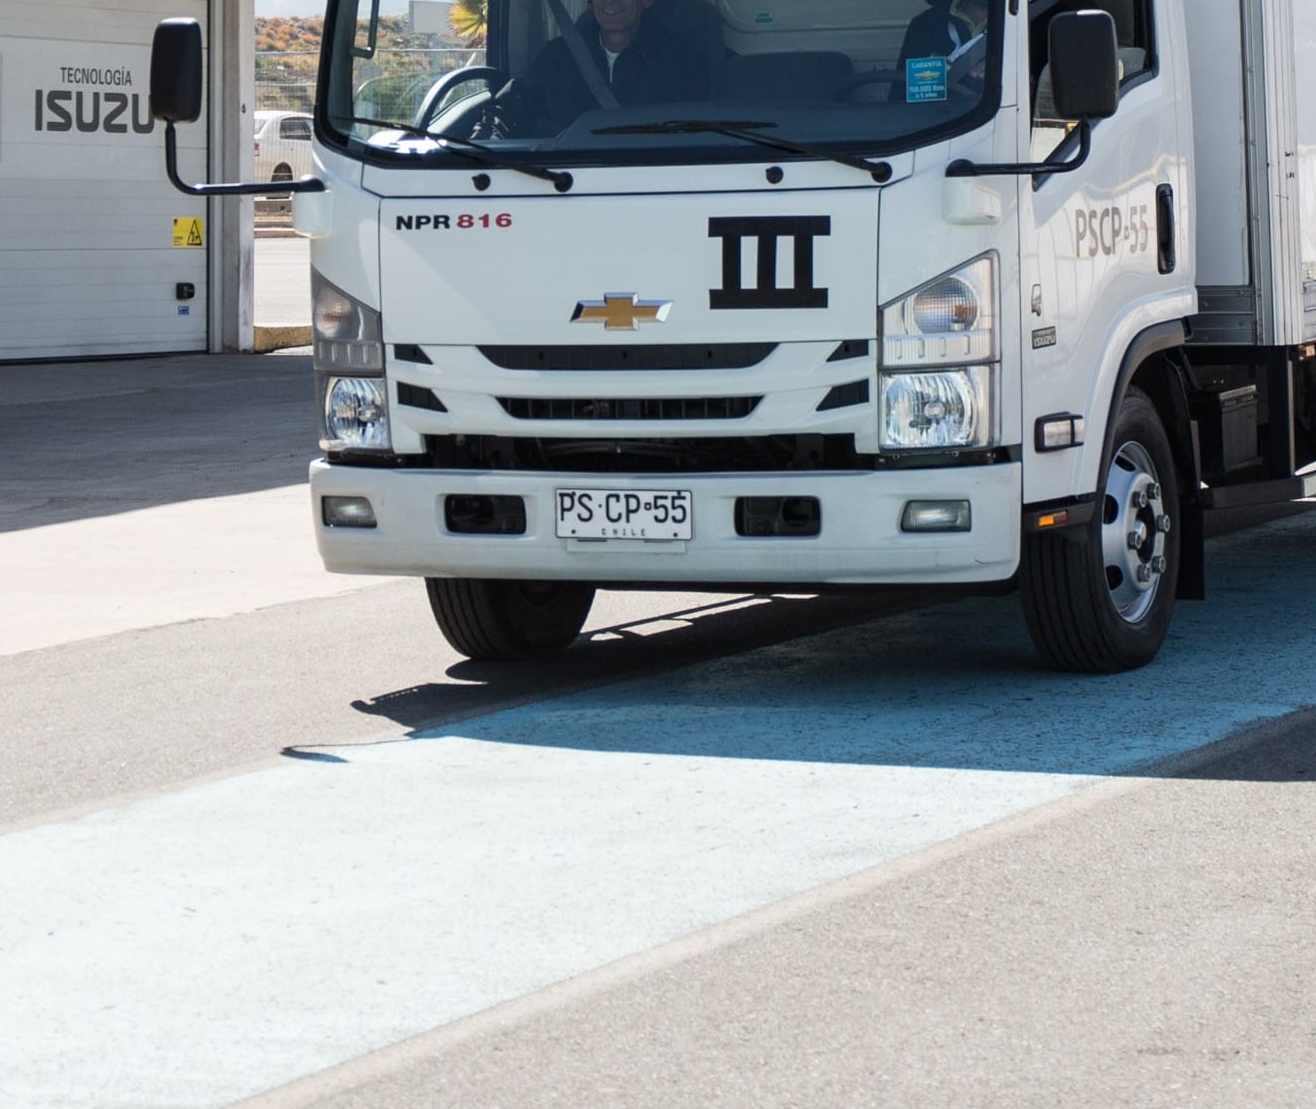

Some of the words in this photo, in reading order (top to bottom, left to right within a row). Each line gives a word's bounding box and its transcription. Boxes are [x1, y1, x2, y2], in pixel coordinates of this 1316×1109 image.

[60, 66, 133, 87] TECNOLOGÍA
[34, 89, 154, 134] ISUZU
[395, 215, 451, 231] NPR
[456, 213, 513, 229] 816
[601, 528, 646, 537] CHILE
